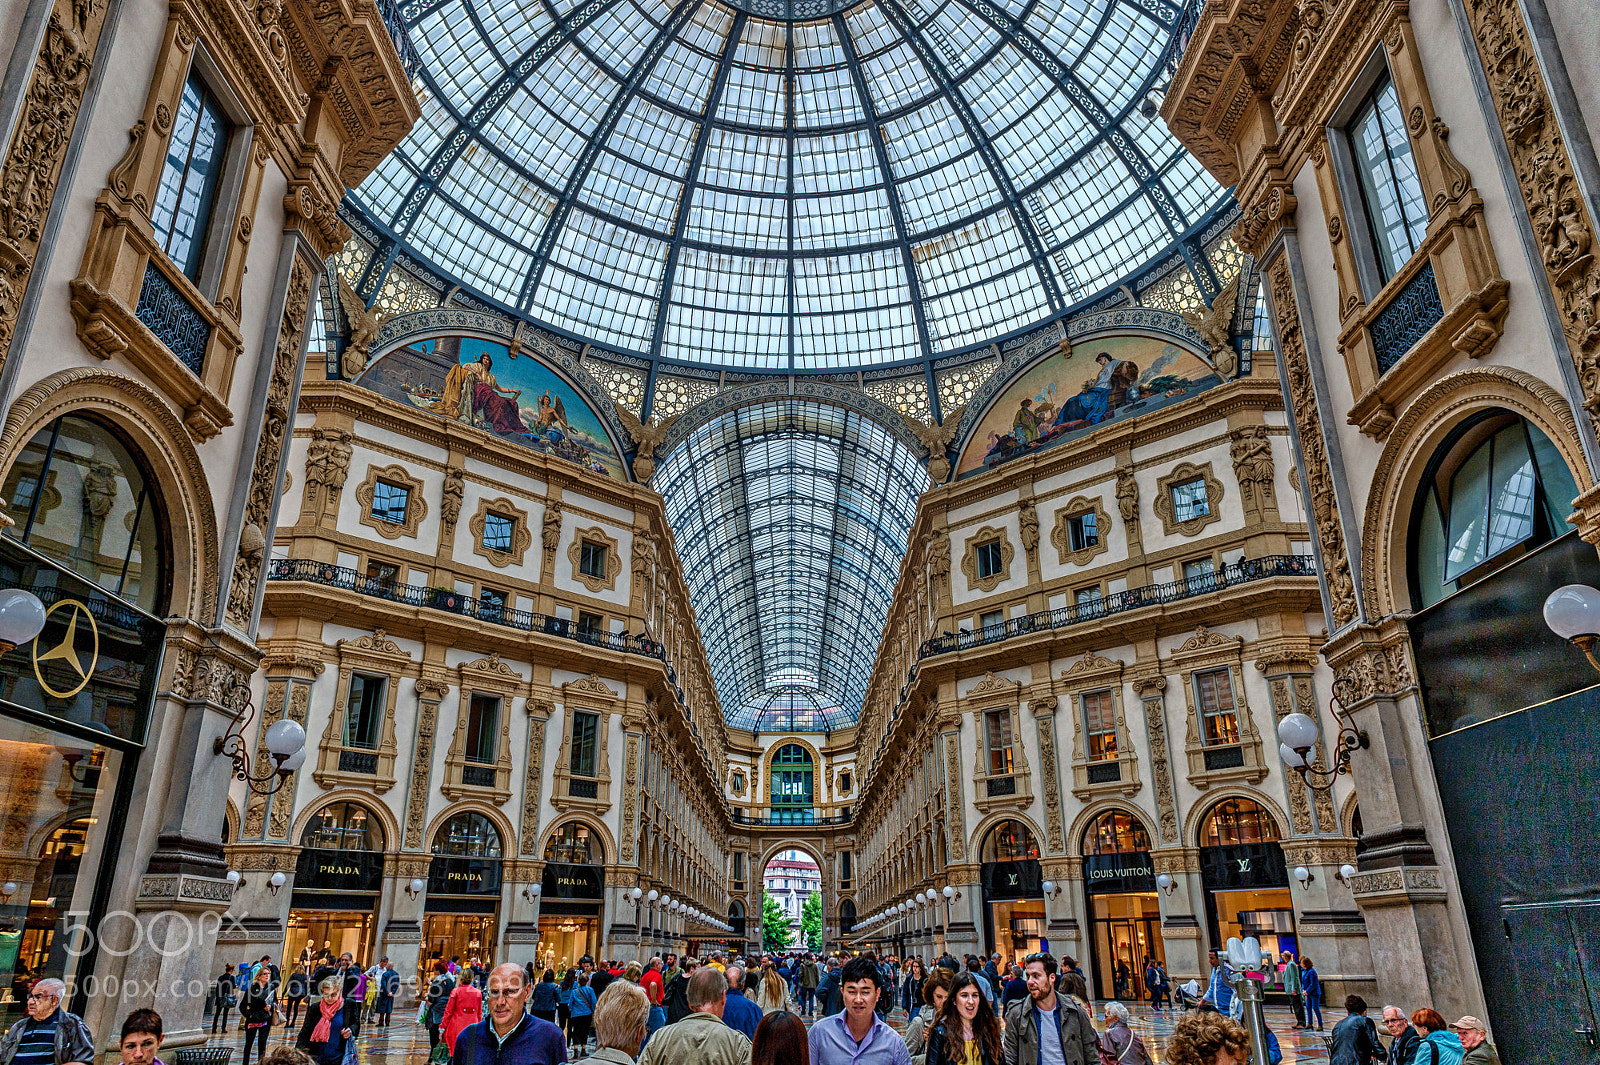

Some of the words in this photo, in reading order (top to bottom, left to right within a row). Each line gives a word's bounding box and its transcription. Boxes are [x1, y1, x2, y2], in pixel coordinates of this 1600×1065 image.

[319, 865, 360, 875] PRADA
[1089, 868, 1114, 879] LOUIS
[1114, 866, 1152, 877] VUITTON
[447, 872, 483, 881] PRADA
[557, 877, 588, 886] PRADA
